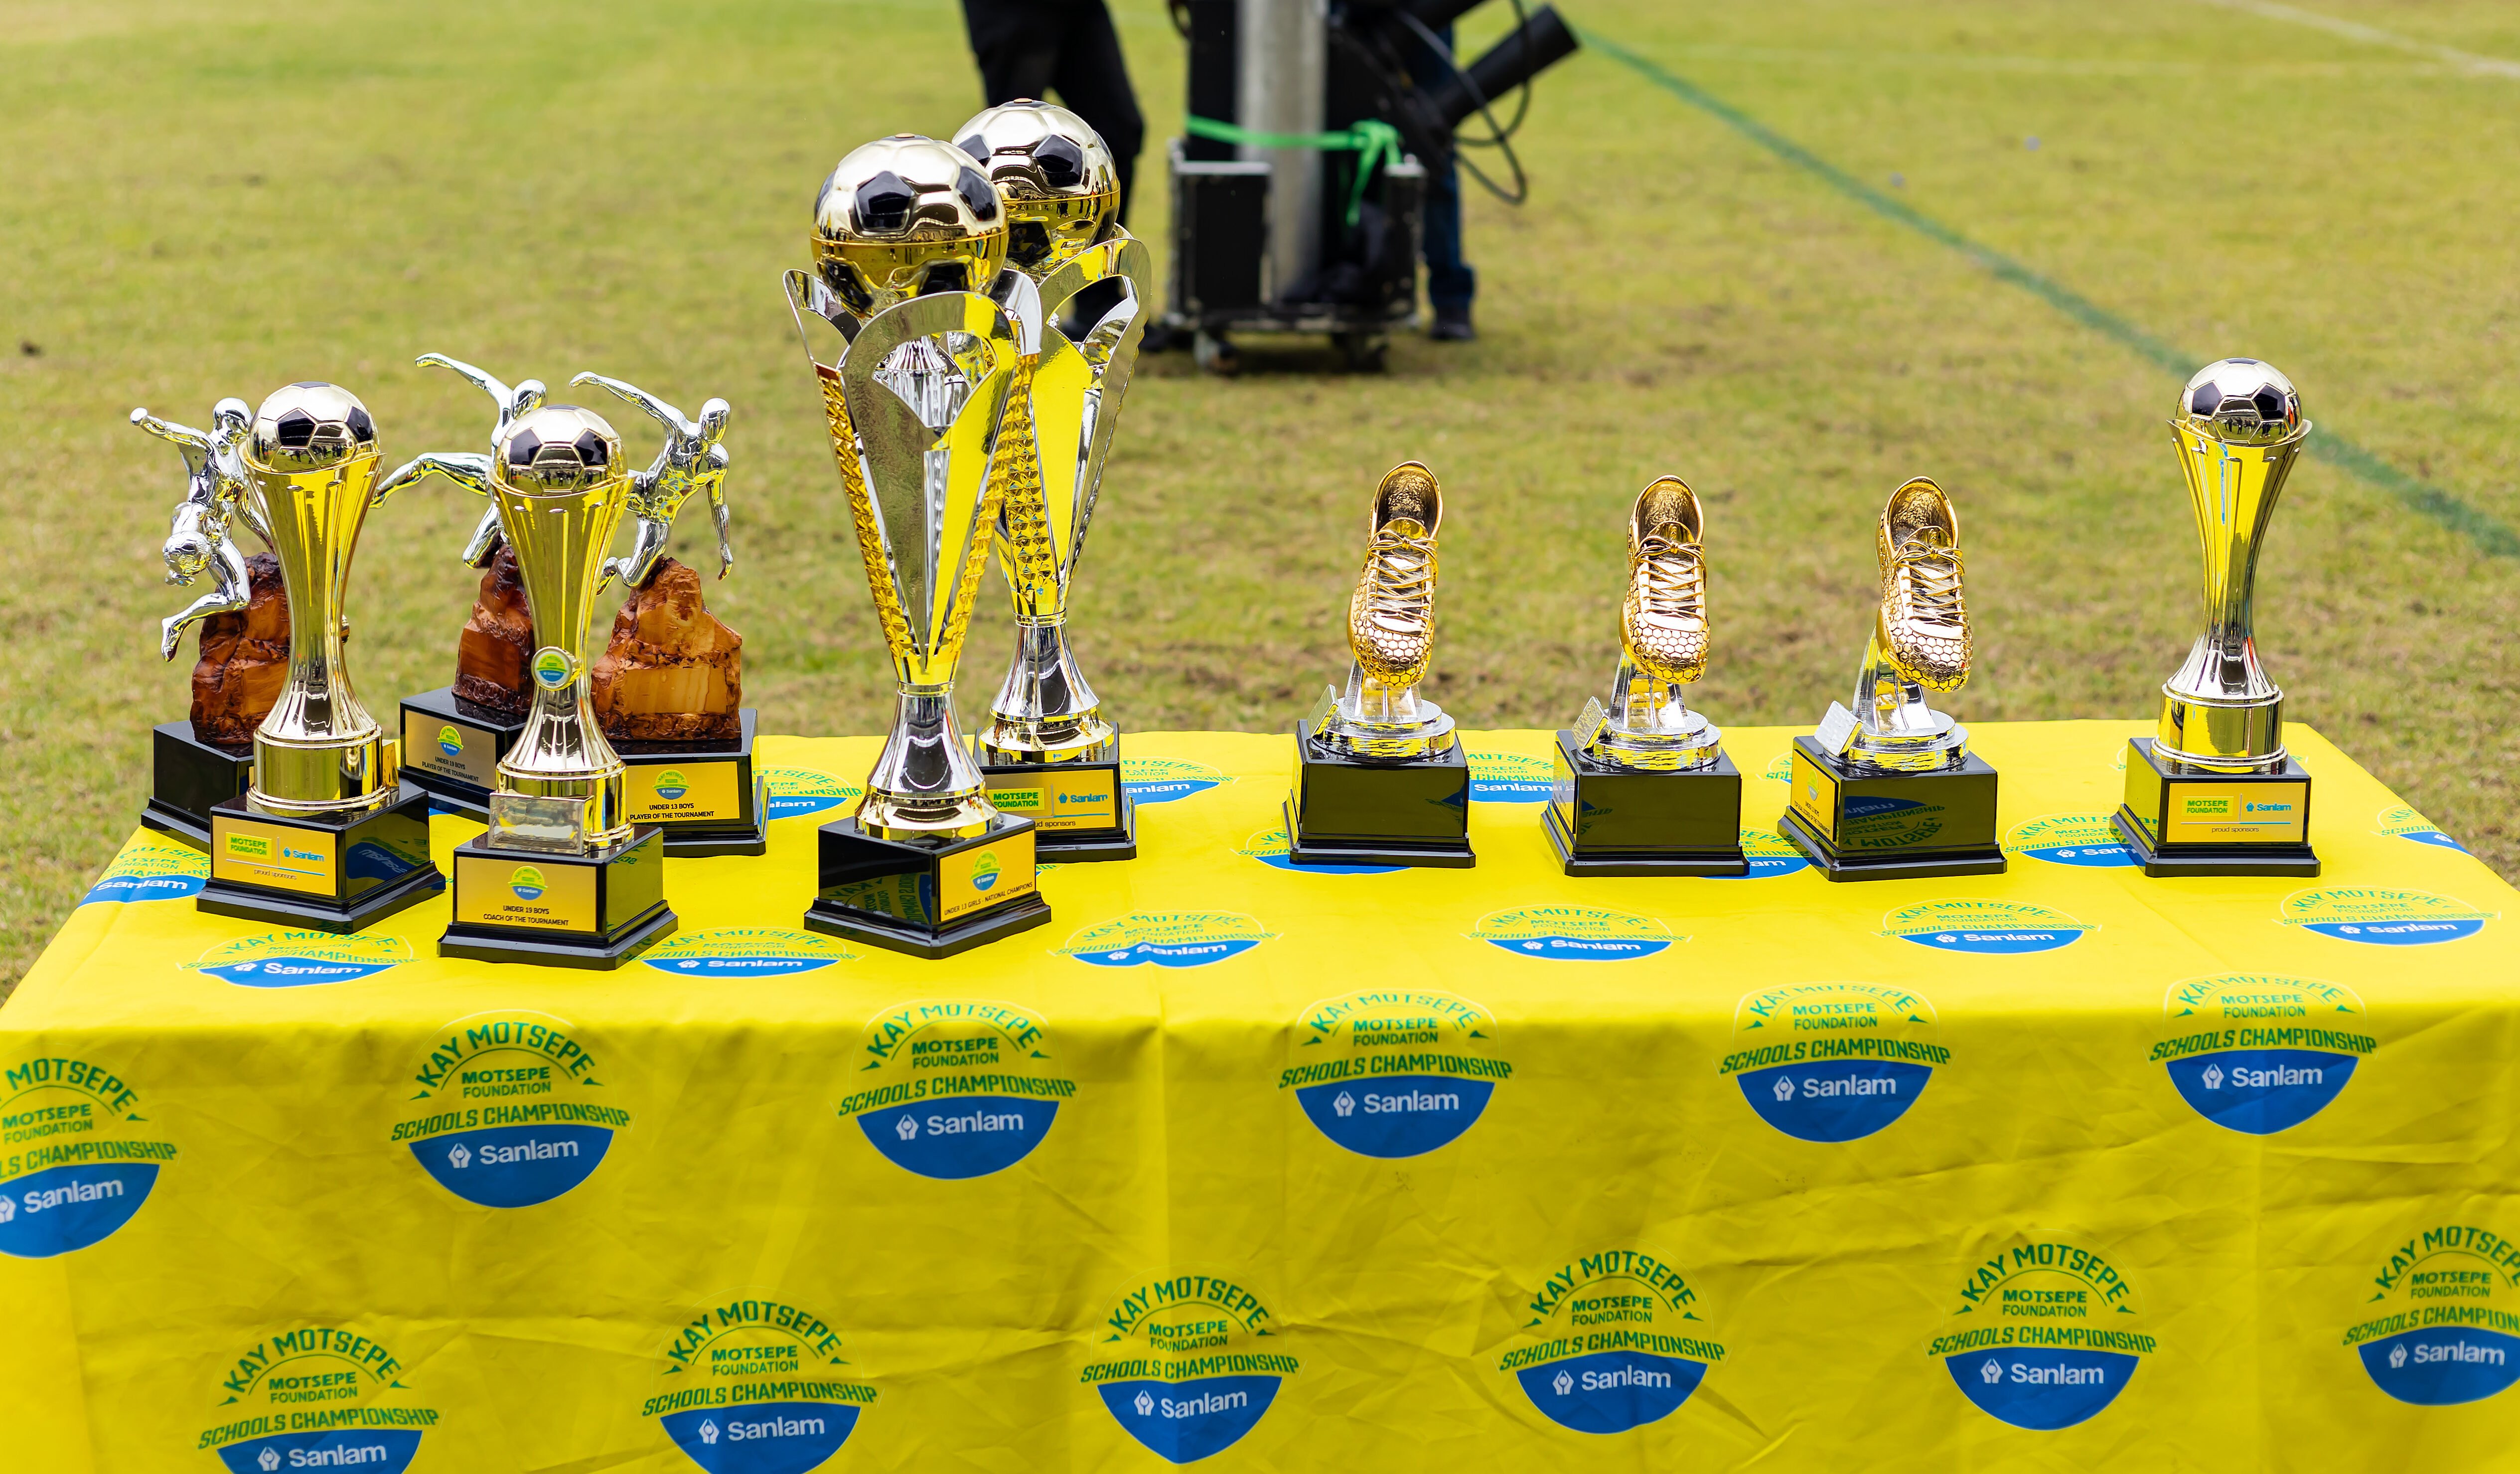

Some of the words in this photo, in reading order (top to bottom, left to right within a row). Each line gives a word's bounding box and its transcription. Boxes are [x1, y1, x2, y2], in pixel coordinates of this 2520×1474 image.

[422, 761, 436, 770] PLAYER
[452, 770, 479, 782] TOURNAMENT
[1070, 793, 1108, 803] Sanlam
[2257, 803, 2291, 811] Sanlam
[2017, 821, 2051, 835] KAY
[231, 837, 267, 848] MOTSEPE
[231, 845, 267, 855] FOUNDATION
[2005, 840, 2075, 852] SCHOOLS
[293, 850, 324, 862] Sanlam
[944, 905, 959, 915] UNDER
[968, 898, 981, 908] GIRLS
[985, 890, 1005, 902] NATIONAL
[1007, 882, 1033, 895] CHAMPIONS
[2293, 893, 2327, 909] KAY
[528, 917, 569, 925] TOURNAMENT
[1495, 911, 1529, 924] KAY
[1895, 905, 1932, 919] KAY
[1083, 921, 1126, 940] KAY
[2366, 923, 2458, 933] Sanlam
[227, 934, 274, 951] KAY
[667, 933, 705, 947] KAY
[1137, 944, 1227, 955] Sanlam
[1550, 940, 1641, 950] Sanlam
[264, 963, 362, 975] Sanlam
[1749, 990, 1789, 1017] KAY
[1793, 985, 1919, 1013] MOTSEPE
[2178, 980, 2216, 1005] KAY
[2222, 977, 2345, 1003] MOTSEPE
[2221, 994, 2304, 1004] MOTSEPE
[1310, 1001, 1353, 1033] KAY
[1358, 994, 1481, 1029] MOTSEPE
[1793, 1003, 1876, 1016] MOTSEPE
[2224, 1006, 2306, 1018] FOUNDATION
[867, 1011, 913, 1058] KAY
[919, 1004, 1042, 1049] MOTSEPE
[1353, 1017, 1437, 1032] MOTSEPE
[1794, 1016, 1877, 1031] FOUNDATION
[911, 1037, 998, 1054] MOTSEPE
[1353, 1032, 1438, 1046] FOUNDATION
[2150, 1030, 2235, 1061] SCHOOLS
[2240, 1029, 2377, 1054] CHAMPIONSHIP
[415, 1036, 462, 1088] KAY
[466, 1022, 595, 1076] MOTSEPE
[913, 1052, 999, 1069] FOUNDATION
[1720, 1041, 1805, 1074] SCHOOLS
[1811, 1038, 1950, 1064] CHAMPIONSHIP
[461, 1067, 550, 1084] MOTSEPE
[1279, 1057, 1365, 1088] SCHOOLS
[1371, 1053, 1512, 1079] CHAMPIONSHIP
[2232, 1064, 2322, 1087] Sanlam
[5, 1058, 139, 1113] MOTSEPE
[463, 1082, 551, 1099] FOUNDATION
[838, 1080, 926, 1116] SCHOOLS
[932, 1075, 1077, 1097] CHAMPIONSHIP
[1803, 1074, 1896, 1098] Sanlam
[1364, 1090, 1459, 1113] Sanlam
[2, 1104, 92, 1129] MOTSEPE
[391, 1109, 478, 1141] SCHOOLS
[483, 1103, 630, 1127] CHAMPIONSHIP
[927, 1111, 1024, 1135] Sanlam
[3, 1119, 93, 1145] FOUNDATION
[26, 1141, 177, 1171] CHAMPIONSHIP
[479, 1140, 579, 1165] Sanlam
[24, 1179, 124, 1213] Sanlam
[1961, 1255, 2007, 1303] KAY
[2013, 1244, 2130, 1303] MOTSEPE
[2375, 1239, 2417, 1290] KAY
[1530, 1265, 1575, 1315] KAY
[1580, 1251, 1696, 1310] MOTSEPE
[2411, 1272, 2493, 1286] MOTSEPE
[2003, 1290, 2087, 1303] MOTSEPE
[2411, 1286, 2491, 1299] FOUNDATION
[1108, 1287, 1150, 1332] KAY
[1154, 1276, 1269, 1329] MOTSEPE
[1571, 1296, 1652, 1313] MOTSEPE
[2002, 1305, 2086, 1318] FOUNDATION
[1572, 1310, 1652, 1326] FOUNDATION
[2343, 1310, 2420, 1345] SCHOOLS
[2423, 1307, 2520, 1332] CHAMPION
[667, 1314, 713, 1362] KAY
[716, 1301, 842, 1358] MOTSEPE
[1149, 1320, 1227, 1337] MOTSEPE
[1150, 1334, 1228, 1352] FOUNDATION
[1499, 1336, 1583, 1371] SCHOOLS
[1588, 1331, 1725, 1361] CHAMPIONSHIP
[1928, 1327, 2014, 1356] SCHOOLS
[2019, 1326, 2157, 1353] CHAMPIONSHIP
[223, 1343, 269, 1393] KAY
[272, 1329, 401, 1381] MOTSEPE
[711, 1345, 797, 1361] MOTSEPE
[2414, 1340, 2505, 1366] Sanlam
[713, 1359, 798, 1376] FOUNDATION
[1081, 1359, 1161, 1382] SCHOOLS
[1165, 1354, 1299, 1379] CHAMPIONSHIP
[1581, 1364, 1671, 1391] Sanlam
[2011, 1363, 2104, 1384] Sanlam
[268, 1372, 356, 1390] MOTSEPE
[271, 1387, 358, 1404] FOUNDATION
[642, 1387, 726, 1417] SCHOOLS
[732, 1382, 877, 1403] CHAMPIONSHIP
[1161, 1391, 1247, 1419] Sanlam
[198, 1414, 286, 1450] SCHOOLS
[291, 1408, 439, 1430] CHAMPIONSHIP
[728, 1417, 825, 1441] Sanlam
[289, 1444, 387, 1467] Sanlam
